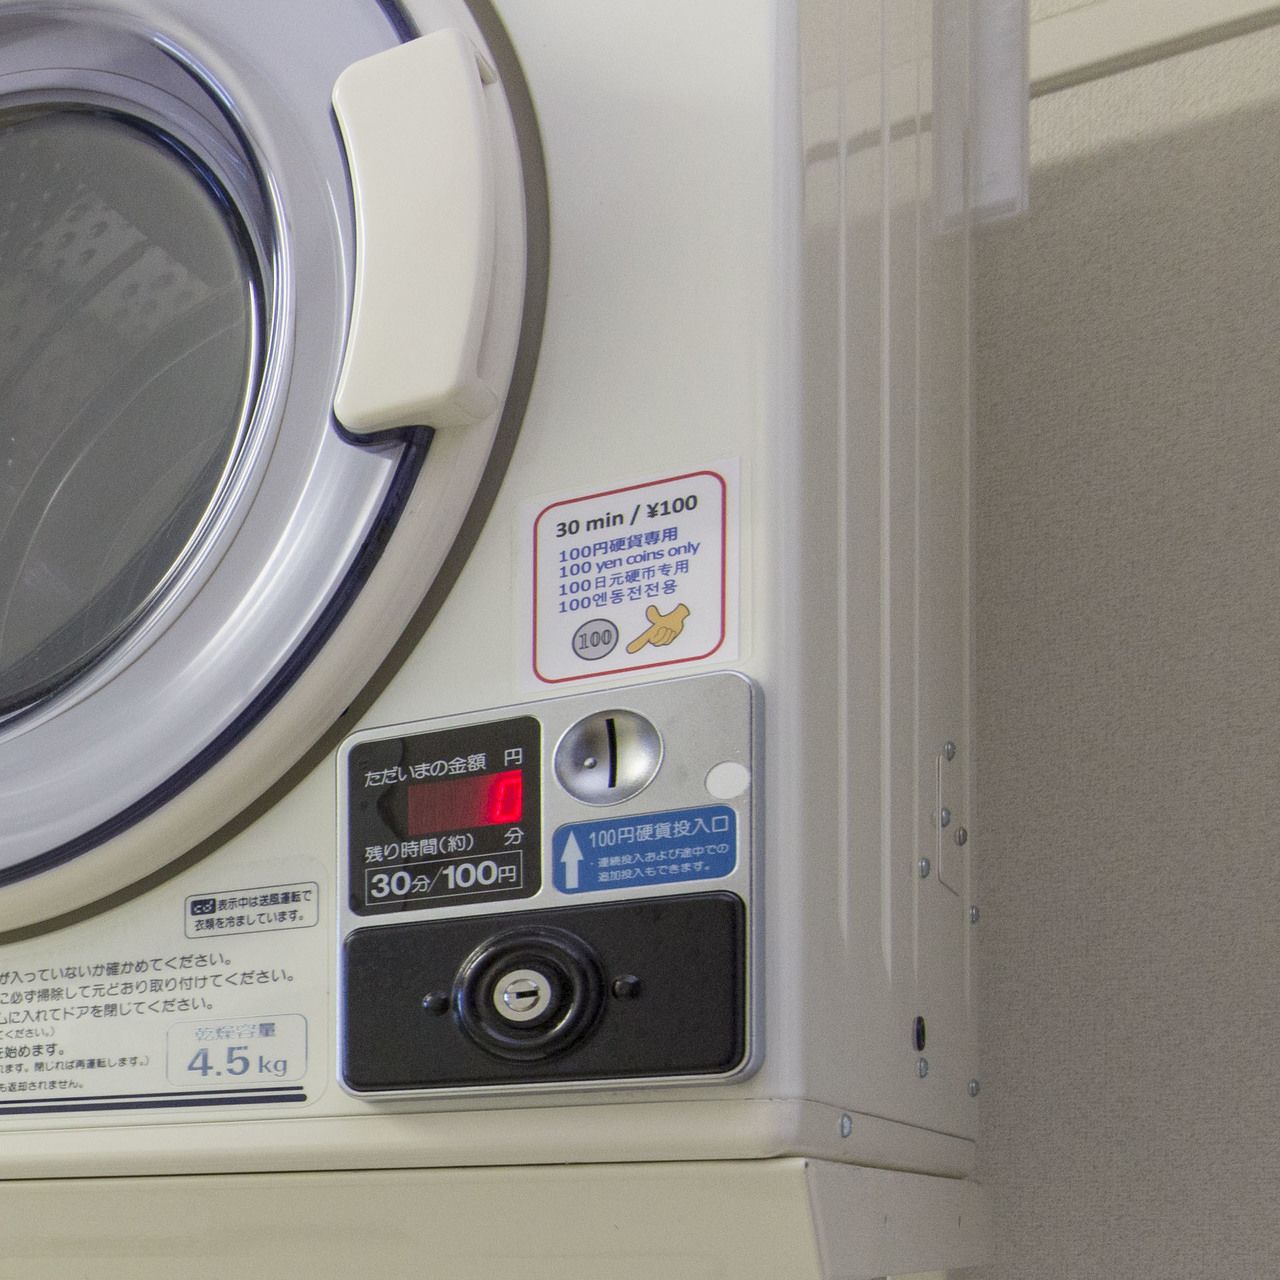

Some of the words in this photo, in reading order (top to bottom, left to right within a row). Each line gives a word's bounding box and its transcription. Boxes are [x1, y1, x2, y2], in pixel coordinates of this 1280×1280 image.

[556, 519, 579, 538] 30
[586, 512, 624, 532] min
[647, 494, 698, 518] ¥100
[559, 526, 678, 563] 100円硬貨専用
[559, 562, 591, 578] 100
[595, 558, 622, 574] yen
[626, 550, 664, 565] coins
[667, 541, 700, 556] only
[559, 559, 689, 596] 100日元硬币专用
[559, 579, 678, 613] 100엔동전전용
[579, 630, 612, 650] 100
[364, 753, 487, 788] ただいまの金額
[504, 748, 522, 765] 円
[365, 836, 474, 863] 残り時間(約)
[504, 828, 524, 845] 分
[589, 815, 729, 848] 100円硬貨投入口
[597, 843, 729, 868] 連続投入および途中での
[370, 862, 517, 898] 30分/100円
[598, 864, 711, 882] 追加投入もできます。
[218, 890, 312, 912] 表示中は送風運転で
[194, 910, 304, 931] 衣類を冷ましています。
[194, 1023, 276, 1041] 乾燥容量
[187, 1046, 250, 1077] 4.5
[258, 1056, 288, 1077] kg
